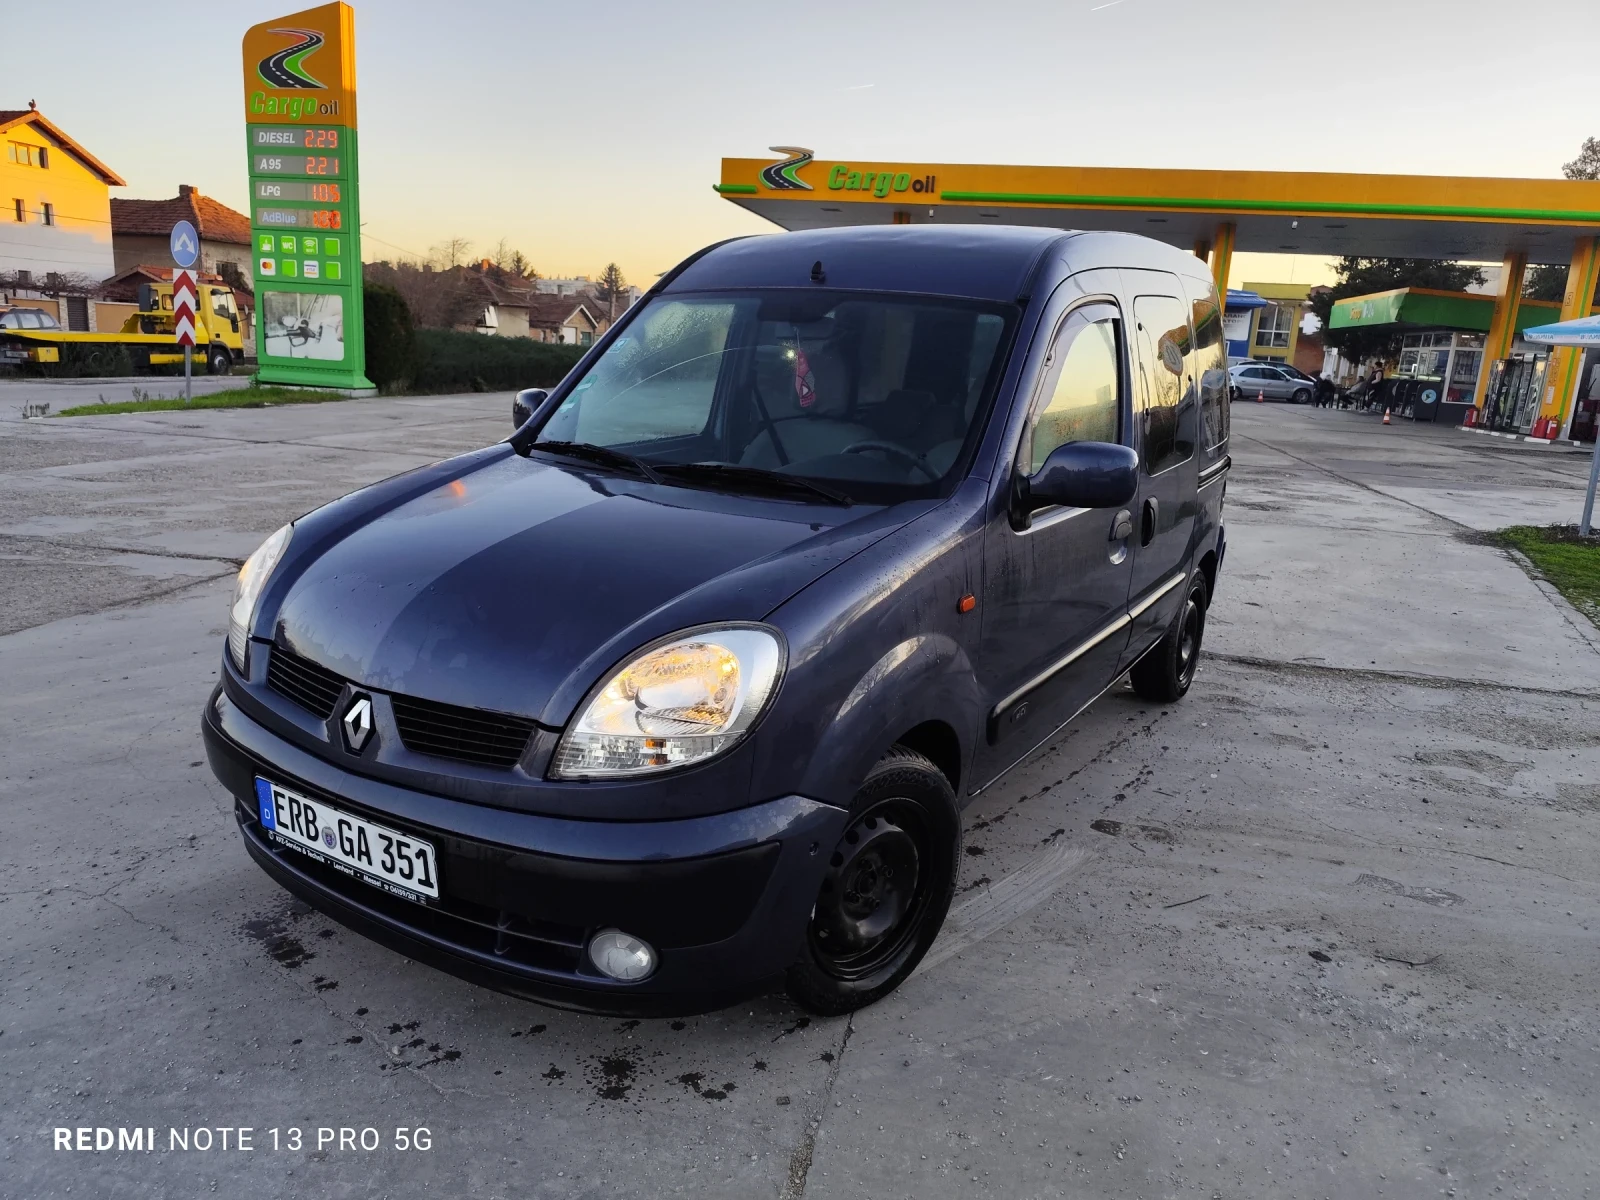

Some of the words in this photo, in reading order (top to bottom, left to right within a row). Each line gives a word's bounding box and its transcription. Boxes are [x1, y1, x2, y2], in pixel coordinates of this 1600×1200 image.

[249, 91, 318, 120] Cargo
[320, 100, 339, 116] oil
[258, 131, 296, 144] DIESEL
[305, 130, 338, 149] 2.29
[306, 157, 339, 175] 2.21
[828, 165, 911, 198] Cargo
[912, 176, 936, 193] oil
[261, 185, 281, 197] LPG
[262, 211, 297, 224] AdBlue
[264, 808, 271, 820] D
[273, 790, 320, 842] ERB
[337, 818, 373, 866] GA
[378, 833, 435, 889] 351
